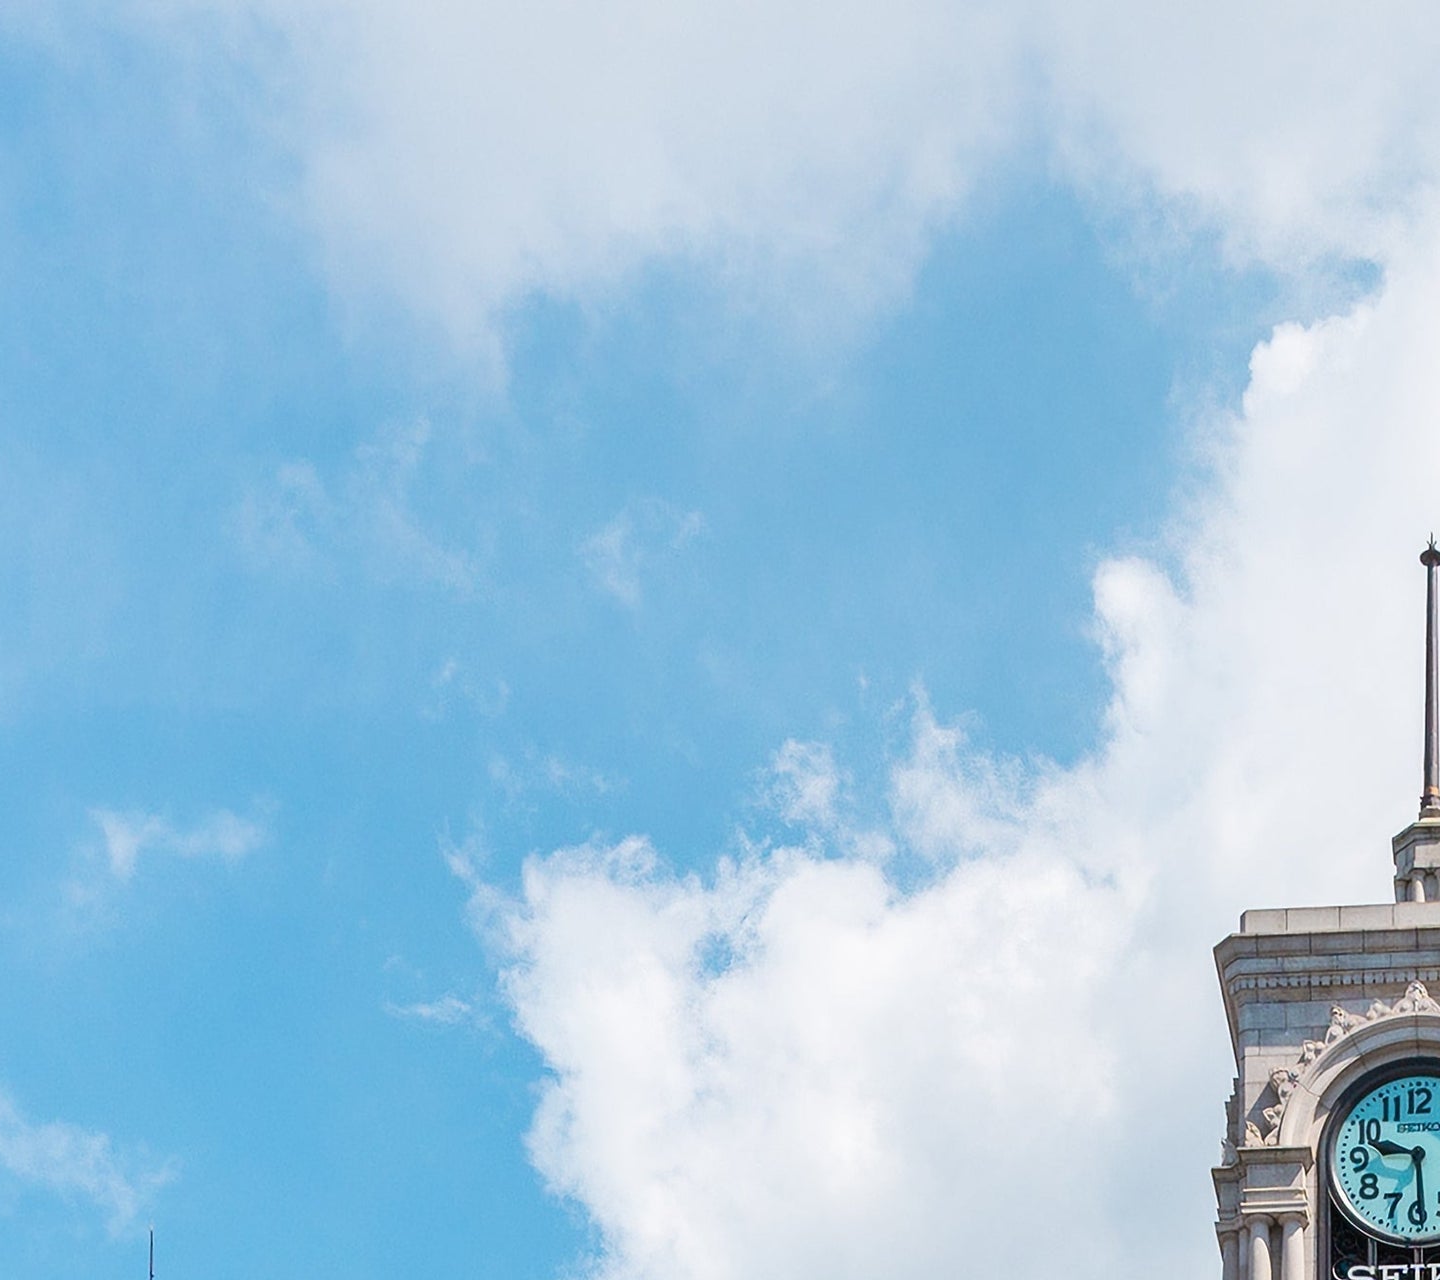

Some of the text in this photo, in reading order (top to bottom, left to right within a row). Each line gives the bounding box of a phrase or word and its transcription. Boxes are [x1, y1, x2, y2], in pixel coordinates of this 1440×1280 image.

[1382, 1096, 1400, 1122] 11
[1408, 1088, 1432, 1114] 12
[1359, 1118, 1381, 1144] 10
[1397, 1122, 1440, 1133] SEIKO
[1350, 1147, 1369, 1173] 9
[1359, 1174, 1379, 1200] 8
[1383, 1193, 1403, 1219] 7
[1407, 1201, 1427, 1226] 6
